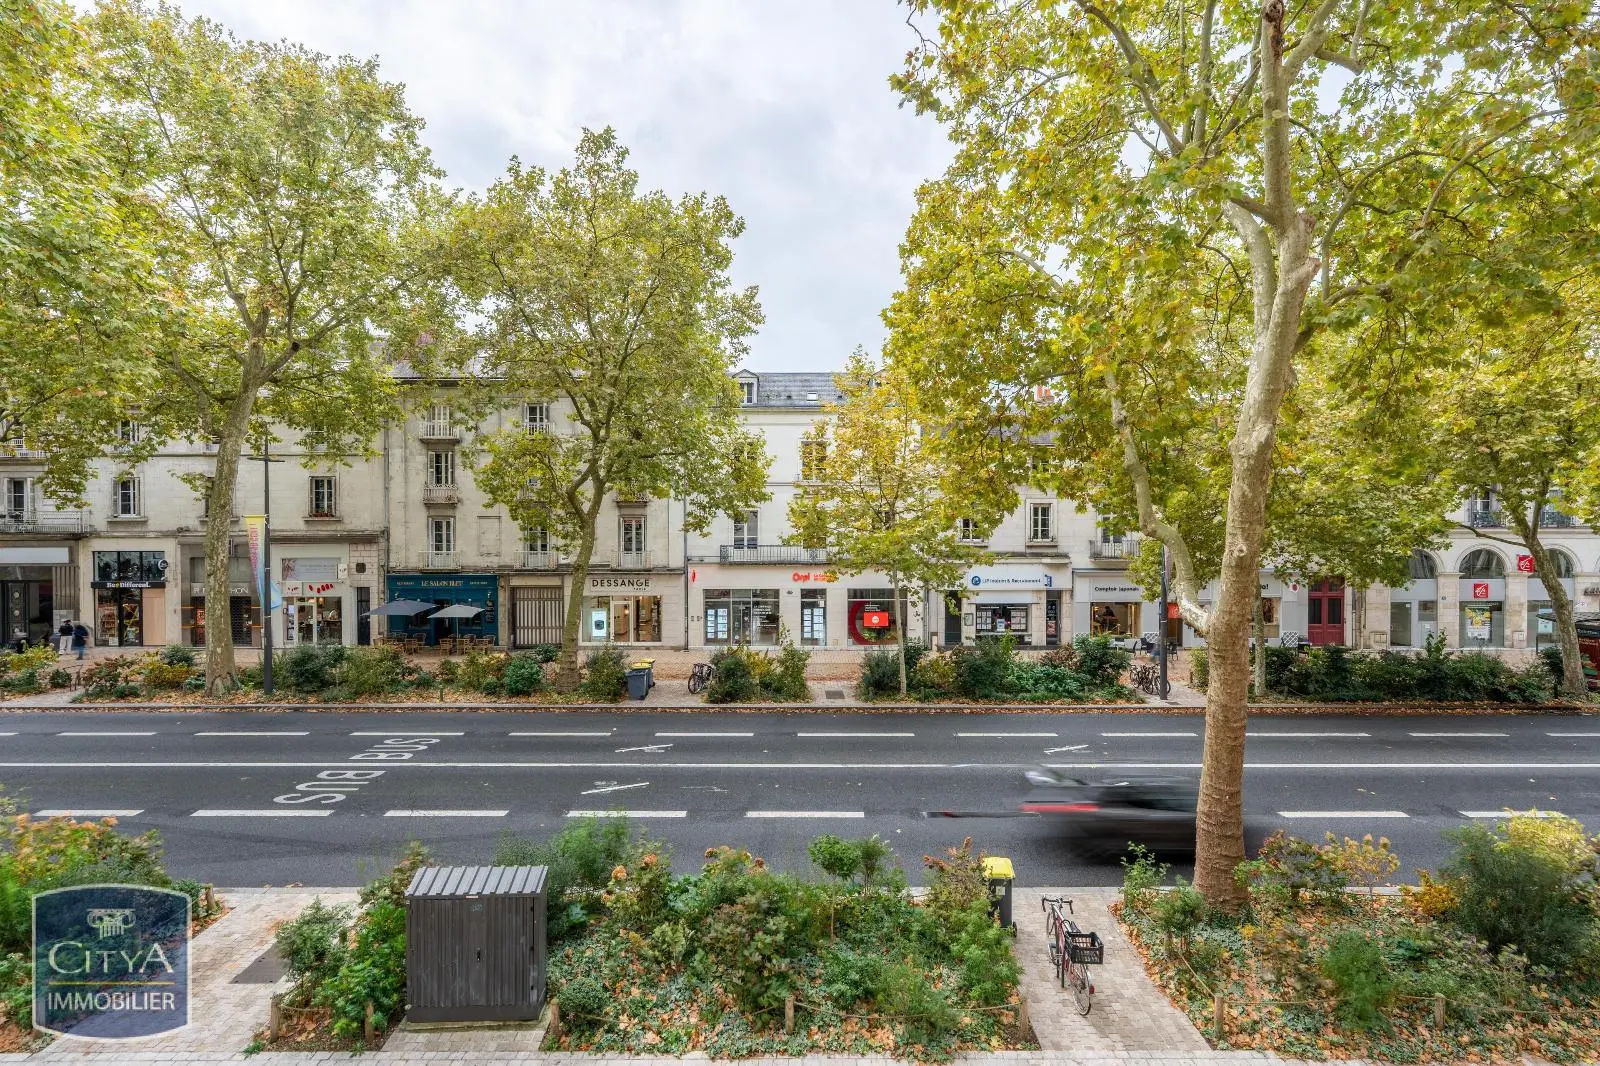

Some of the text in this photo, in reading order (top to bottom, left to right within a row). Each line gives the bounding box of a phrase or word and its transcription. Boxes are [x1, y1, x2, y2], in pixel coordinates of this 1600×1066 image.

[592, 579, 650, 588] DESSANGE
[349, 738, 441, 760] BUS
[272, 770, 387, 805] BUS
